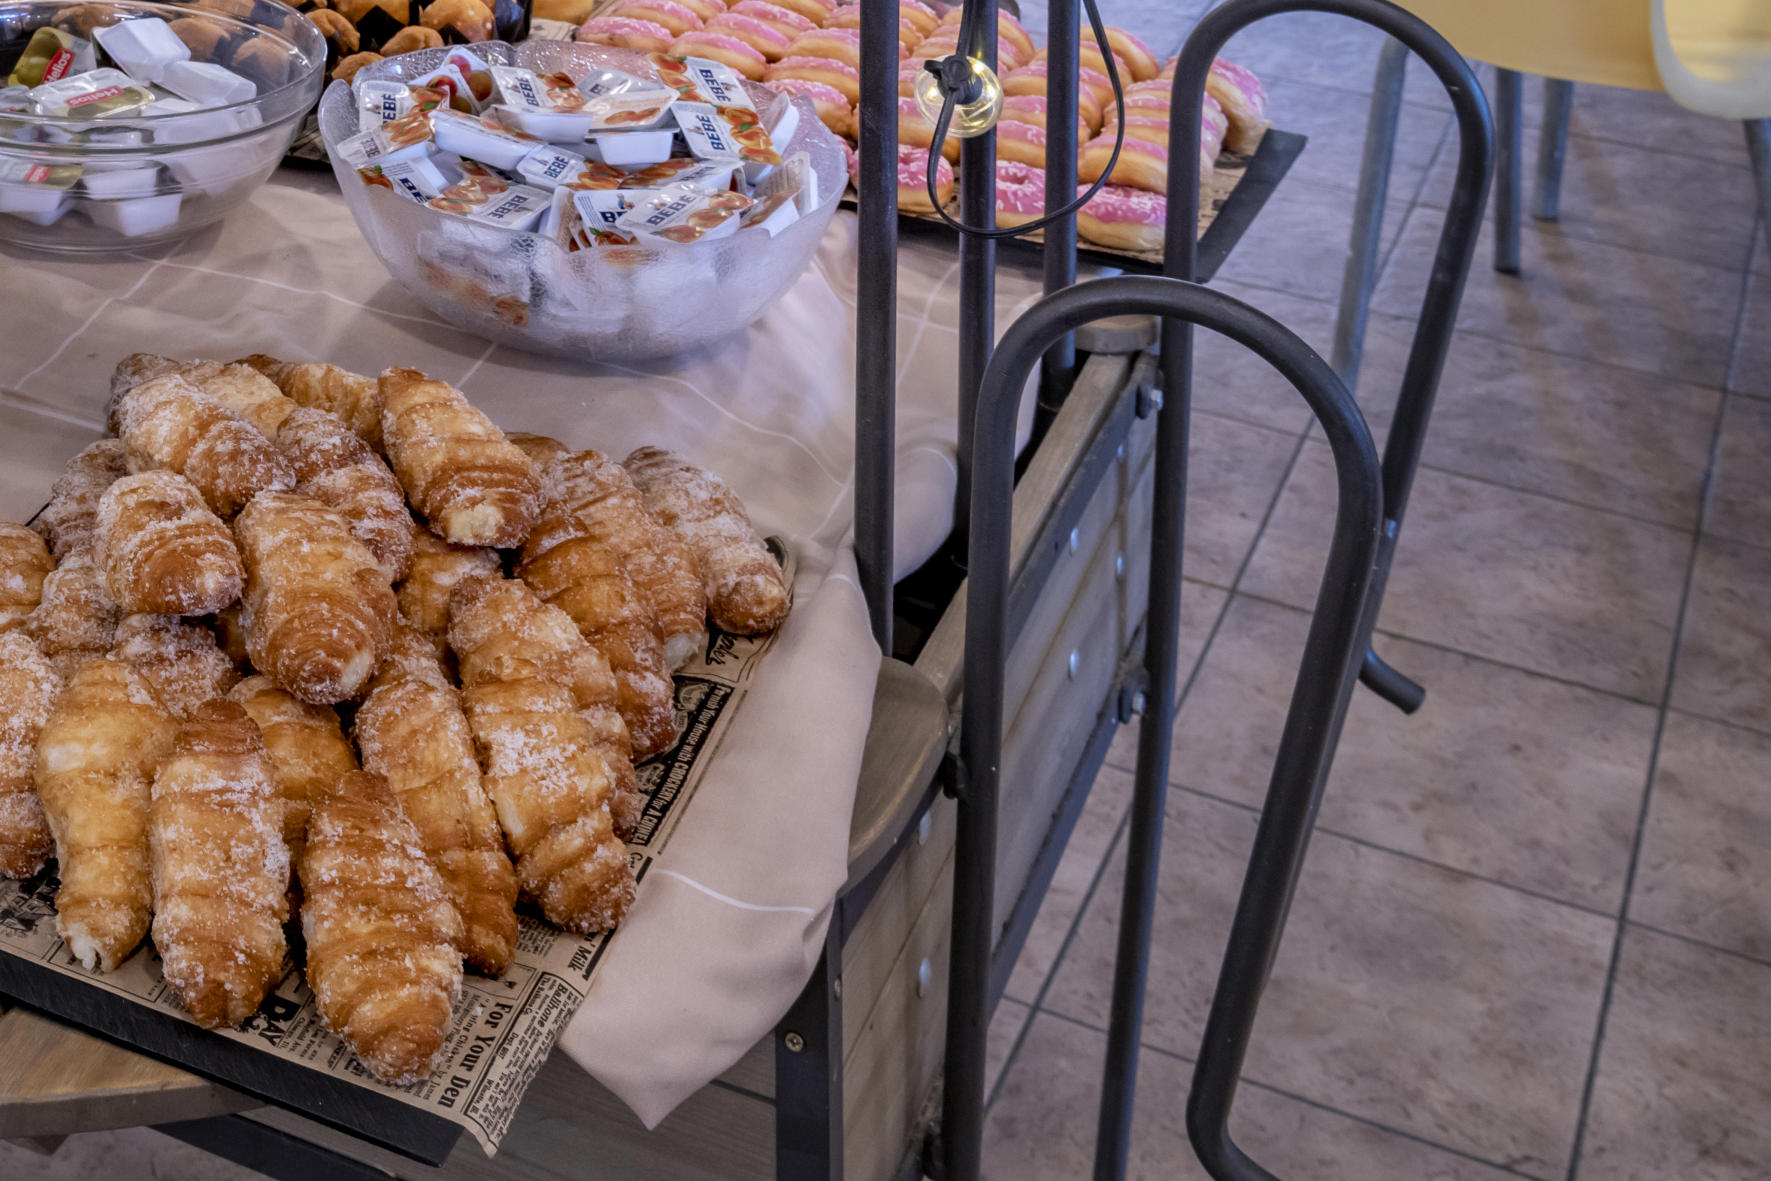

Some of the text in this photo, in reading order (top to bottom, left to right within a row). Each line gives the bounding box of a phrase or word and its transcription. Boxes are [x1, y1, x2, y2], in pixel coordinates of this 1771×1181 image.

[43, 50, 72, 85] Helios
[69, 86, 119, 106] Helios
[517, 75, 540, 107] BEBÉ
[698, 68, 732, 103] BEBÉ
[382, 92, 397, 124] EBÉ
[695, 113, 727, 152] BEBÉ
[543, 155, 570, 179] BEBÉ
[488, 194, 529, 219] BEBÉ
[599, 210, 628, 224] BE
[645, 194, 698, 226] BEBÉ
[709, 685, 732, 712] Furnish
[702, 705, 719, 727] Your
[691, 722, 709, 749] House
[677, 742, 696, 762] with
[661, 760, 690, 808] CROCKERY
[647, 806, 663, 817] A
[652, 797, 667, 811] for
[567, 945, 593, 972] Milk
[490, 1000, 515, 1030] For
[458, 1032, 497, 1072] Your
[425, 1080, 441, 1101] James
[436, 1074, 472, 1109] Den
